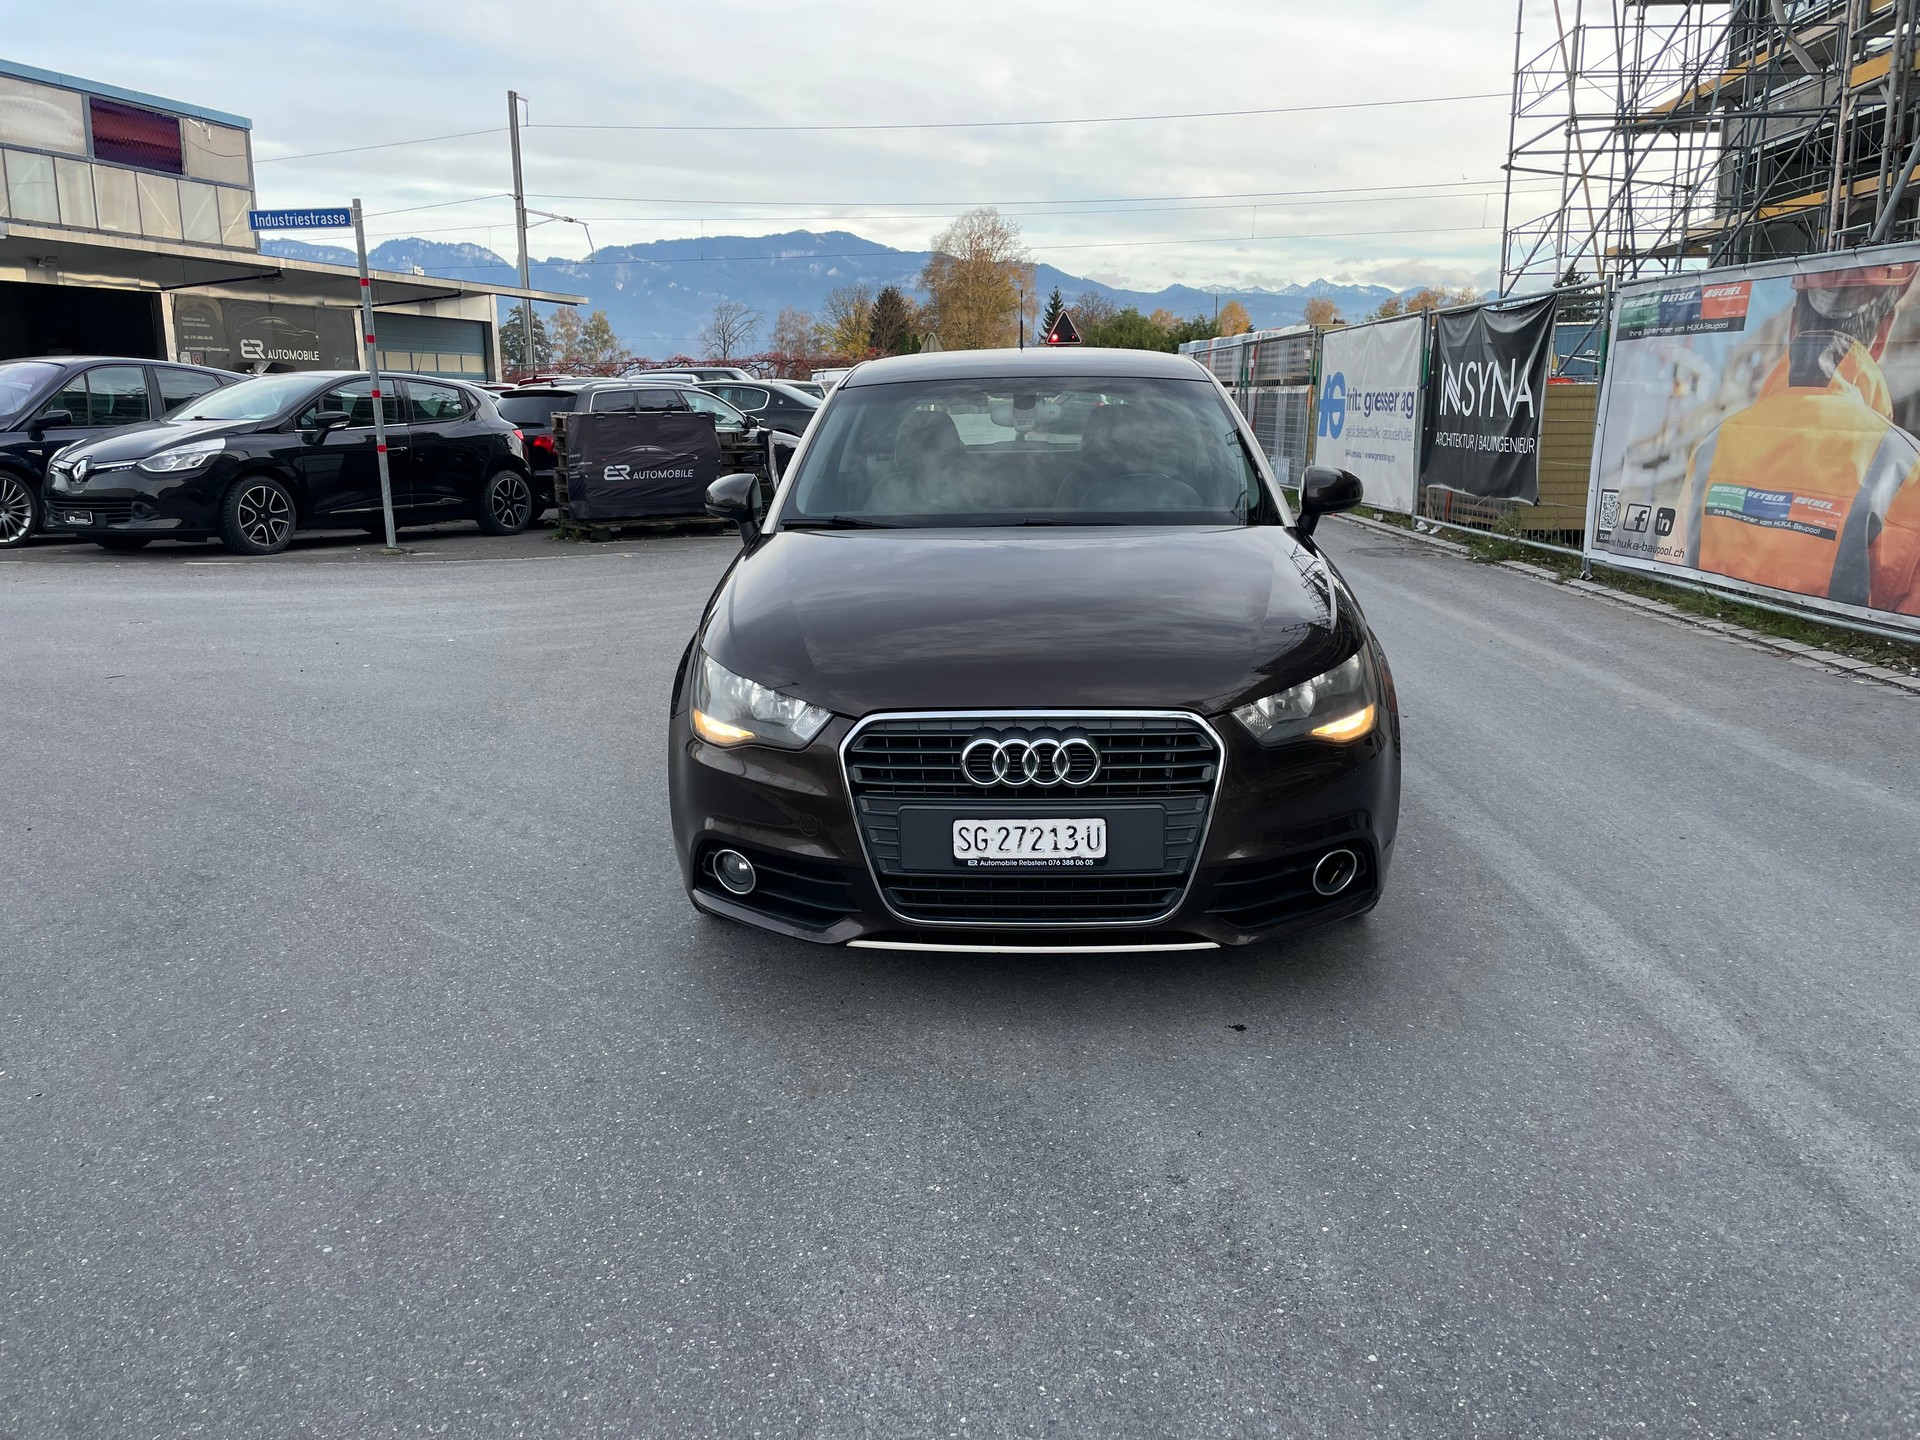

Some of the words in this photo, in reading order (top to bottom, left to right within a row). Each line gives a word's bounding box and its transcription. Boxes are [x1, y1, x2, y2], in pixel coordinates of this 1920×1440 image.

[254, 212, 346, 227] Industriestrasse
[267, 349, 320, 361] AUTOMOBILE
[1346, 387, 1362, 411] fritz
[1363, 391, 1400, 418] gresser
[1400, 391, 1415, 419] ag
[633, 469, 694, 480] AUTOMOBILE
[1747, 490, 1787, 502] VETSCH
[1713, 508, 1725, 516] Ihre
[1725, 510, 1758, 524] Baupartner
[1759, 519, 1773, 527] vom
[1773, 520, 1821, 536] HUKA-Baupool
[979, 859, 1018, 867] Automobile
[1018, 859, 1047, 867] Rebstein
